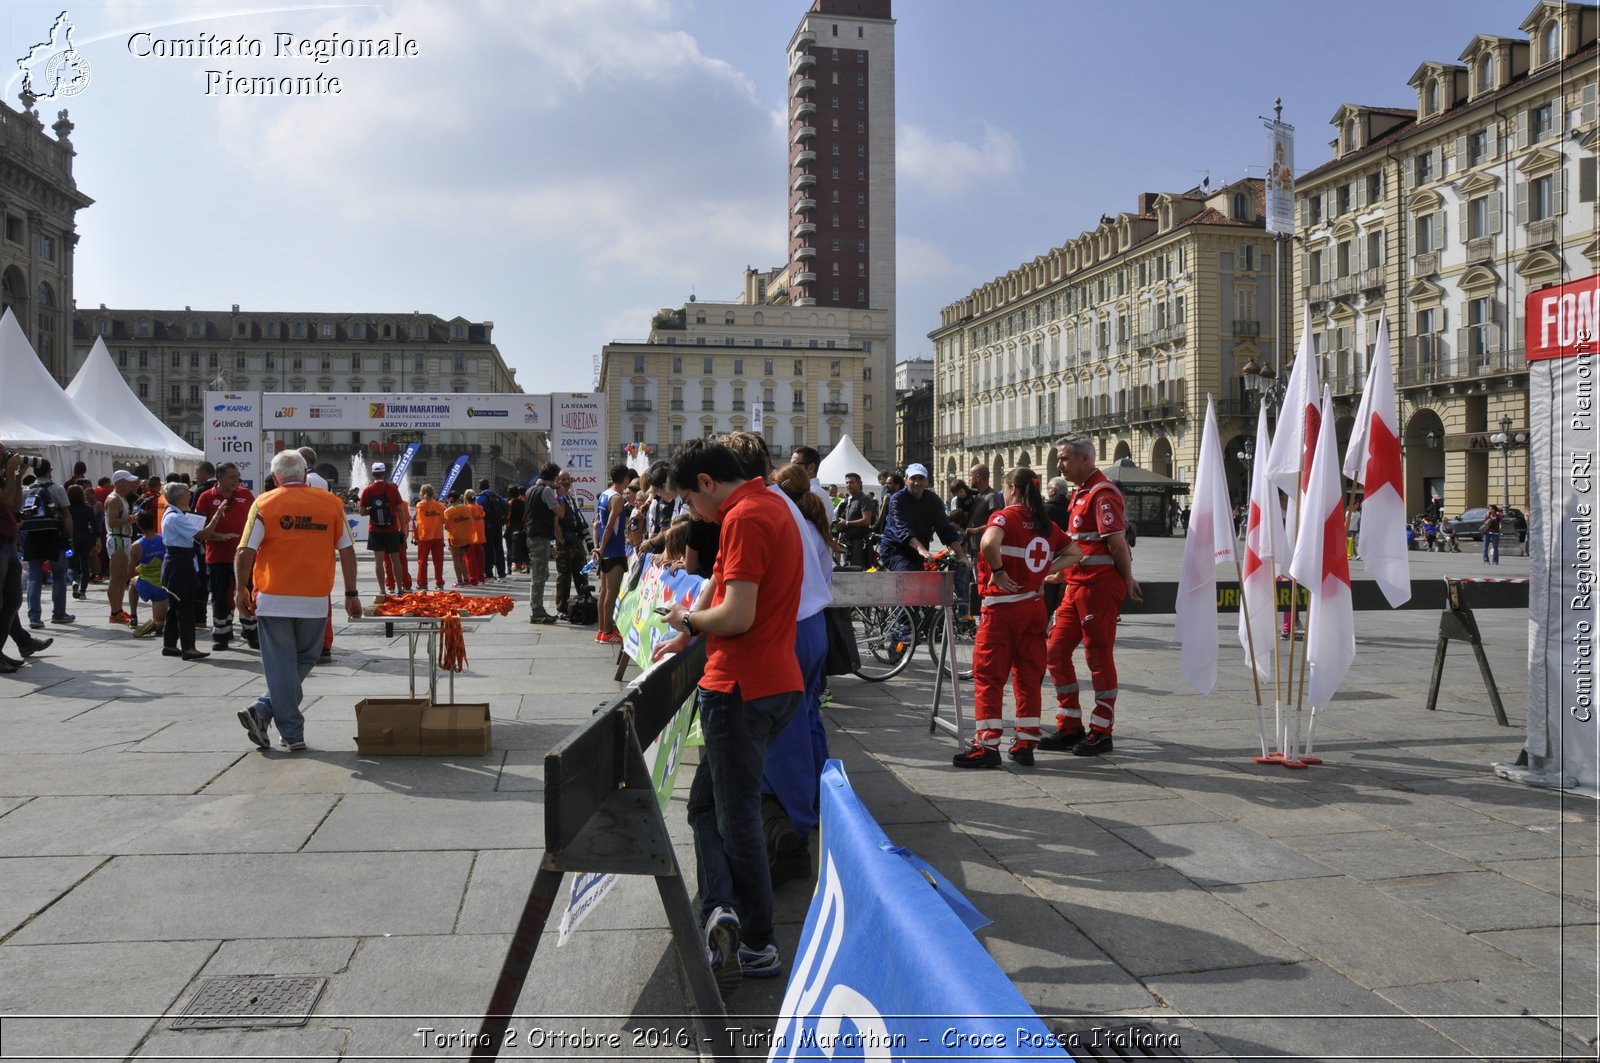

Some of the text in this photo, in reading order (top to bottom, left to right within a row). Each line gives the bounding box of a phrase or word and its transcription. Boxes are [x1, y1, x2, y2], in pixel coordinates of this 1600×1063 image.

[386, 405, 450, 413] TURIN MARATHON
[221, 419, 253, 428] UniCredit
[561, 412, 598, 429] LAURETANA
[222, 438, 252, 452] iren
[566, 454, 593, 468] ZTE
